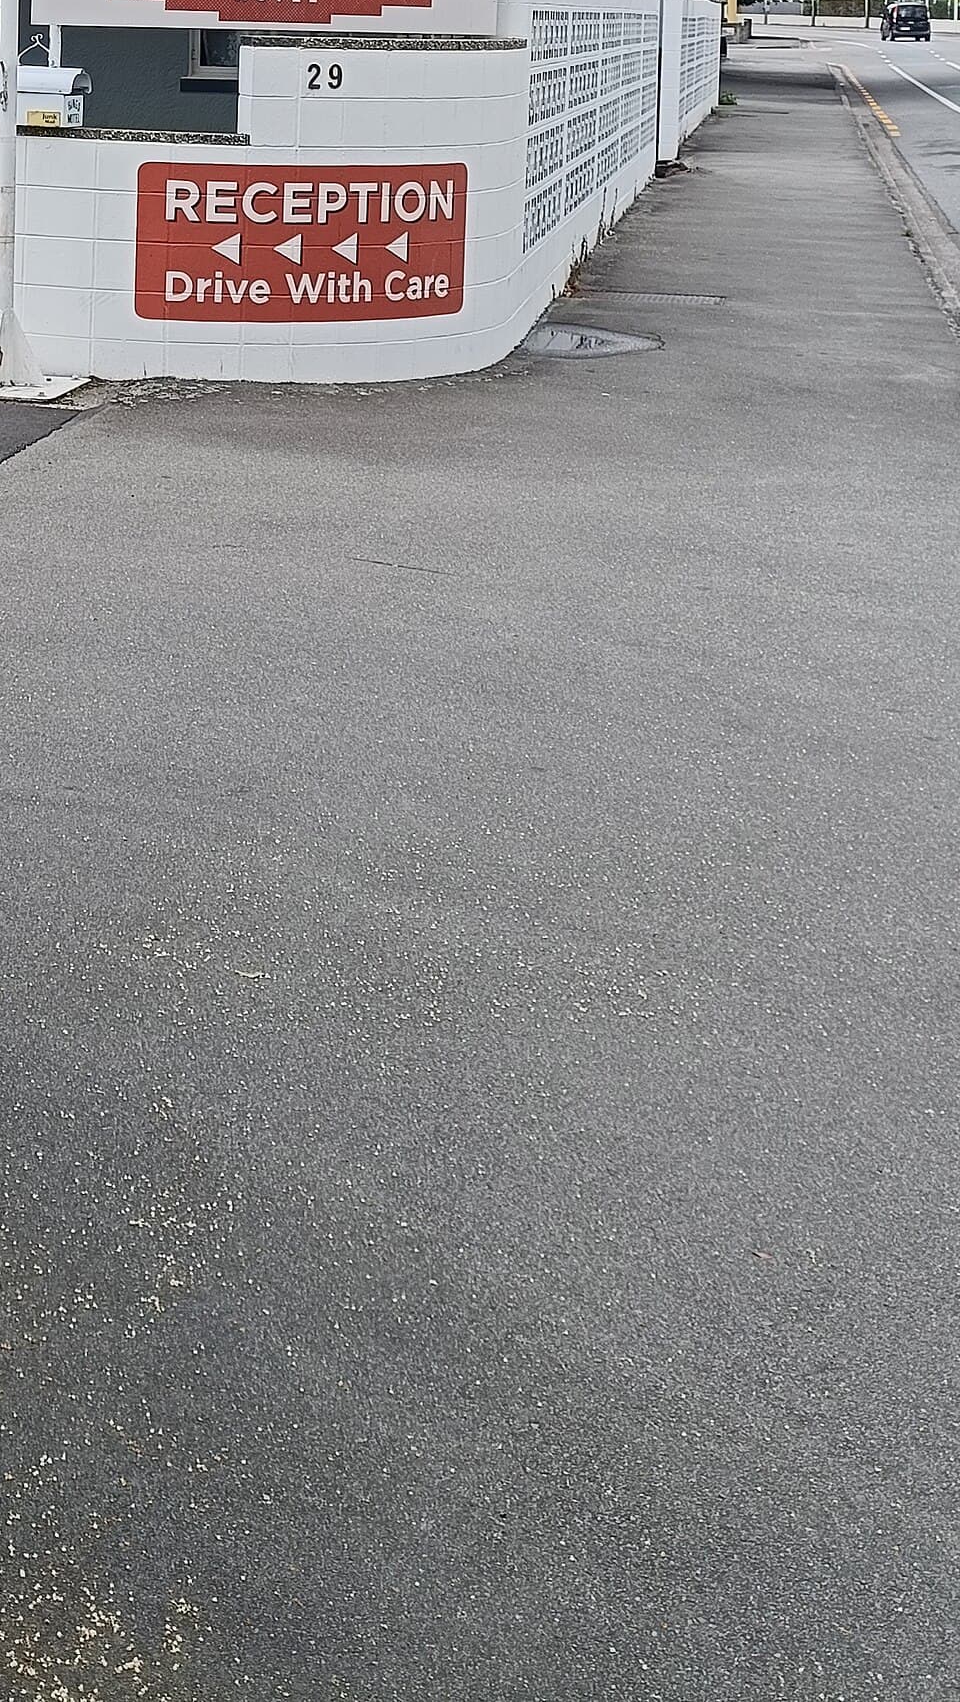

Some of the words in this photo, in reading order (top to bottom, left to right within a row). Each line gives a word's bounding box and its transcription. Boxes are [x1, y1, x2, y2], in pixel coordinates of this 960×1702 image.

[307, 63, 343, 90] 29
[164, 178, 455, 225] RECEPTION
[164, 271, 272, 304] Drive
[285, 271, 373, 305] With
[384, 270, 450, 302] Care
